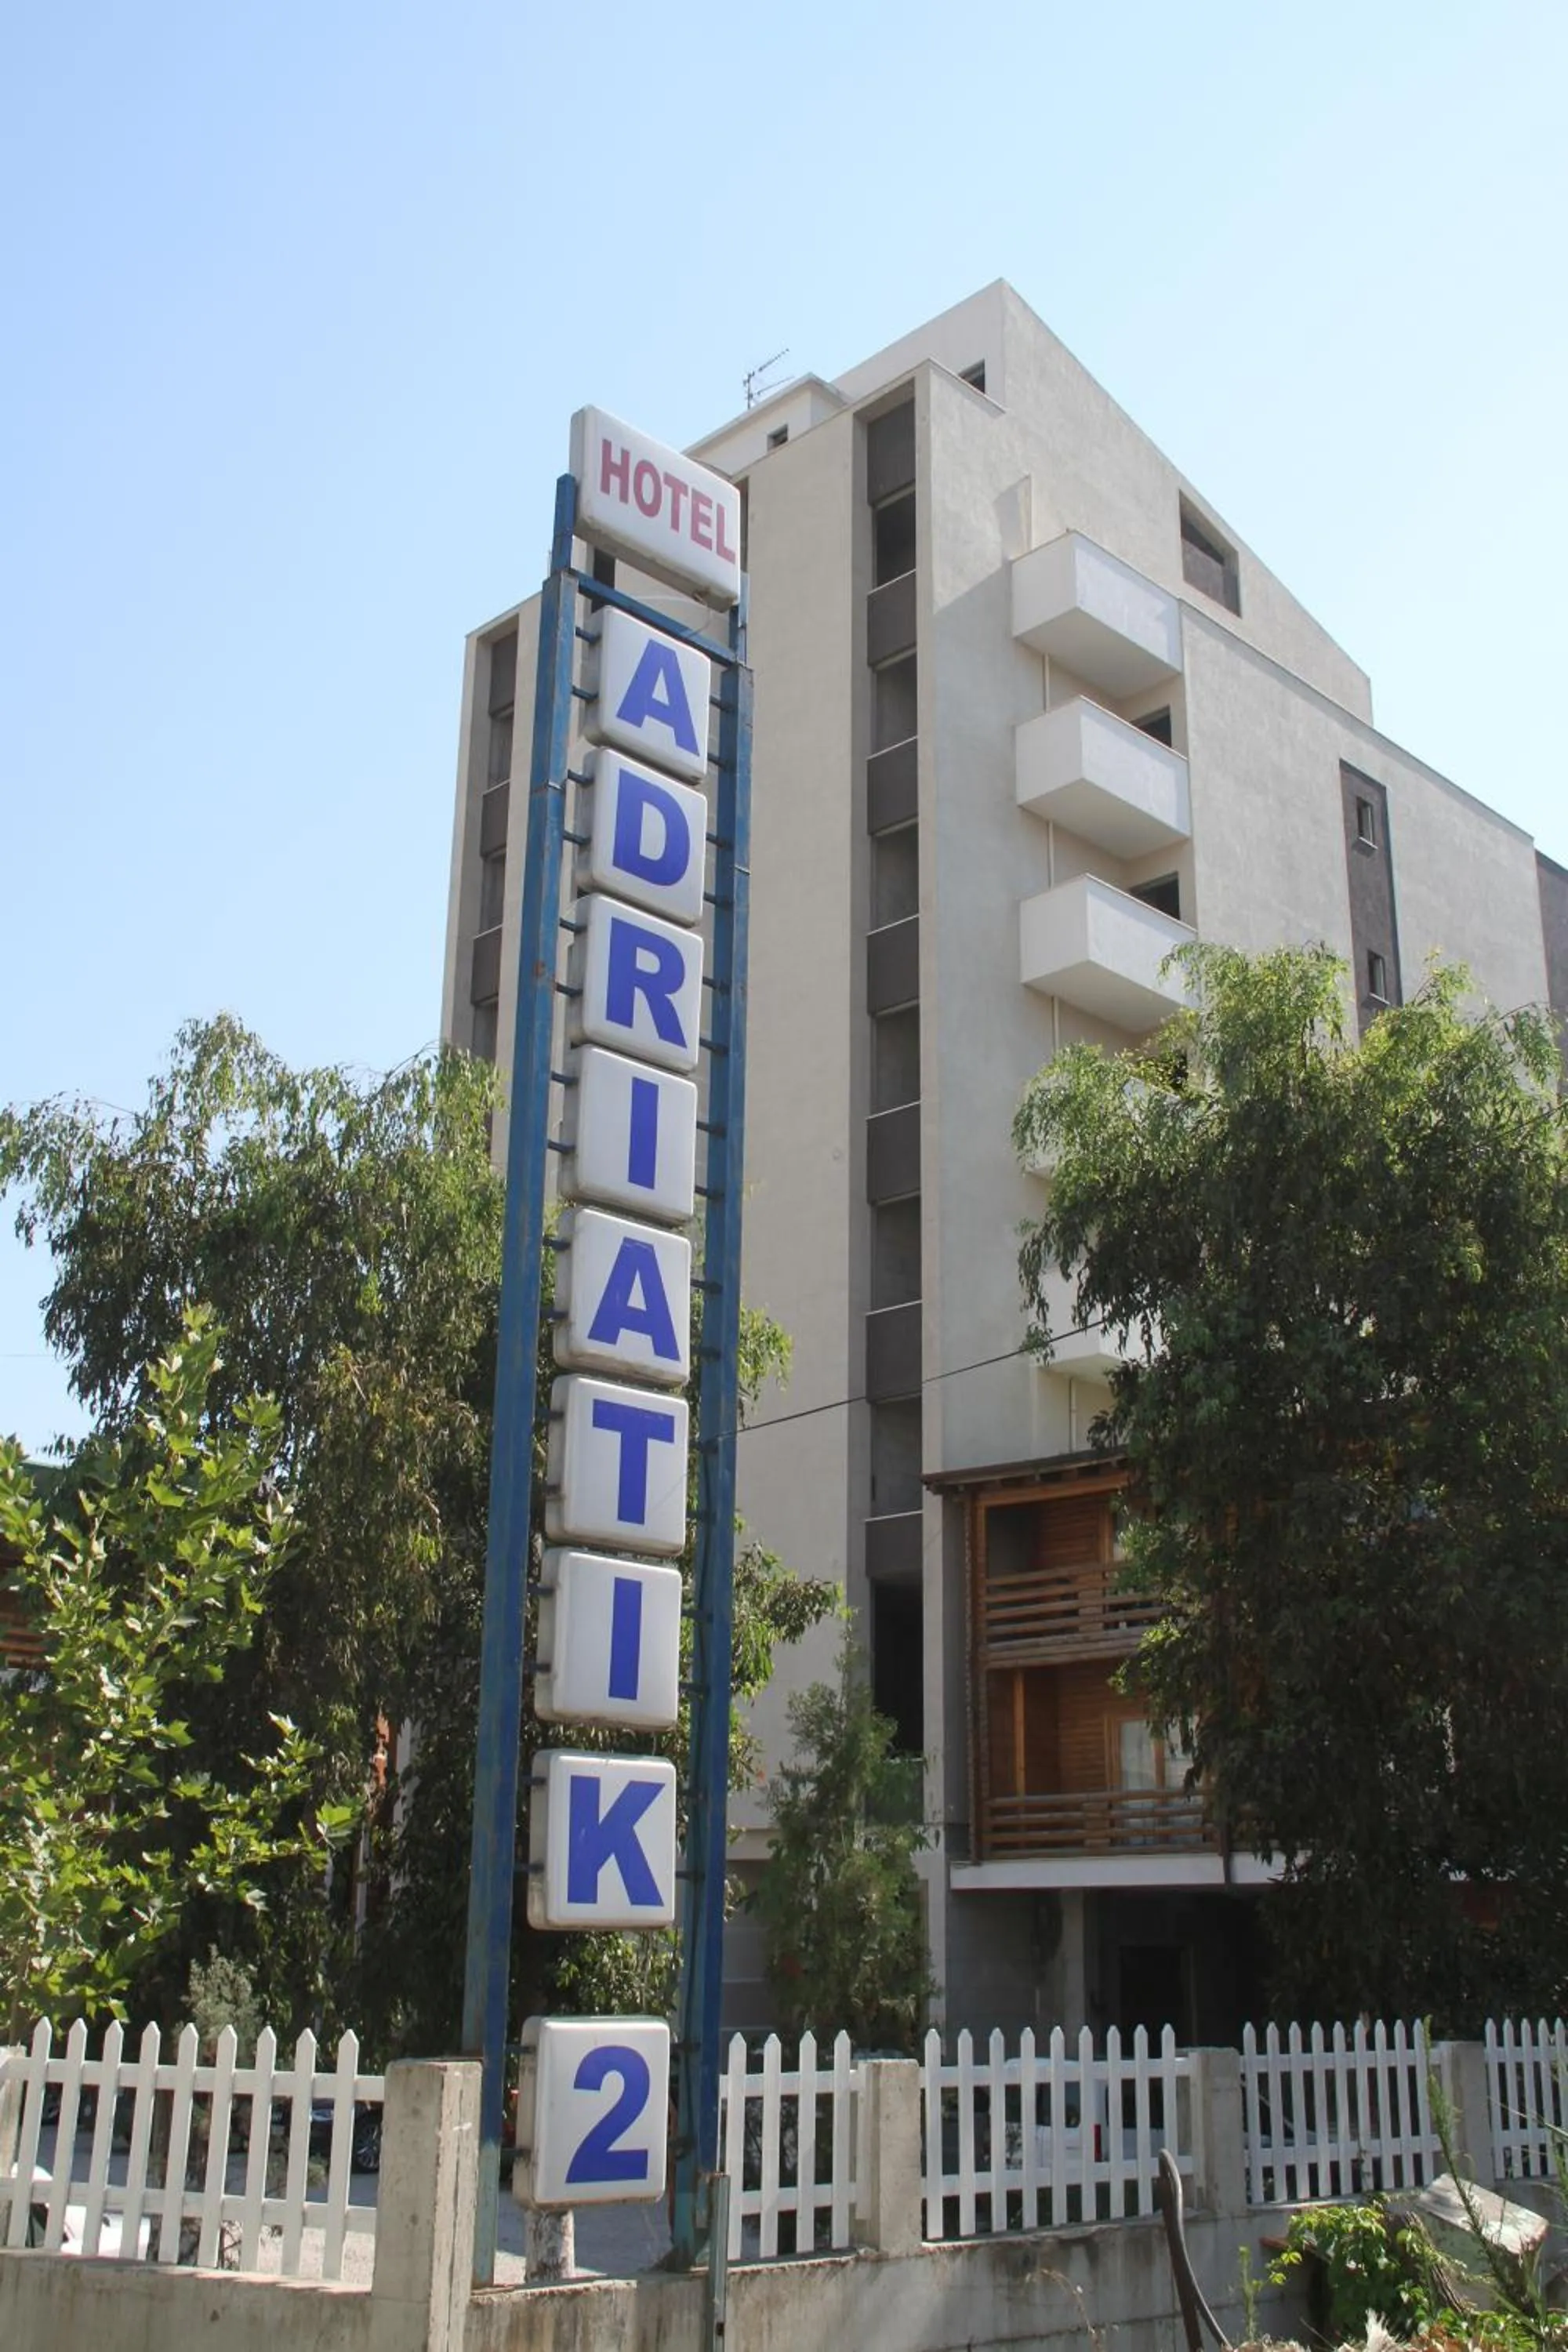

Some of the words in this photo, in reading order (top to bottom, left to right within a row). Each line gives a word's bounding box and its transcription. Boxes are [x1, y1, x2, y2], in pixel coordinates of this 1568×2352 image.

[601, 438, 735, 564] HOTEL
[567, 639, 700, 1907] ADRIATIK
[564, 2044, 650, 2184] 2
